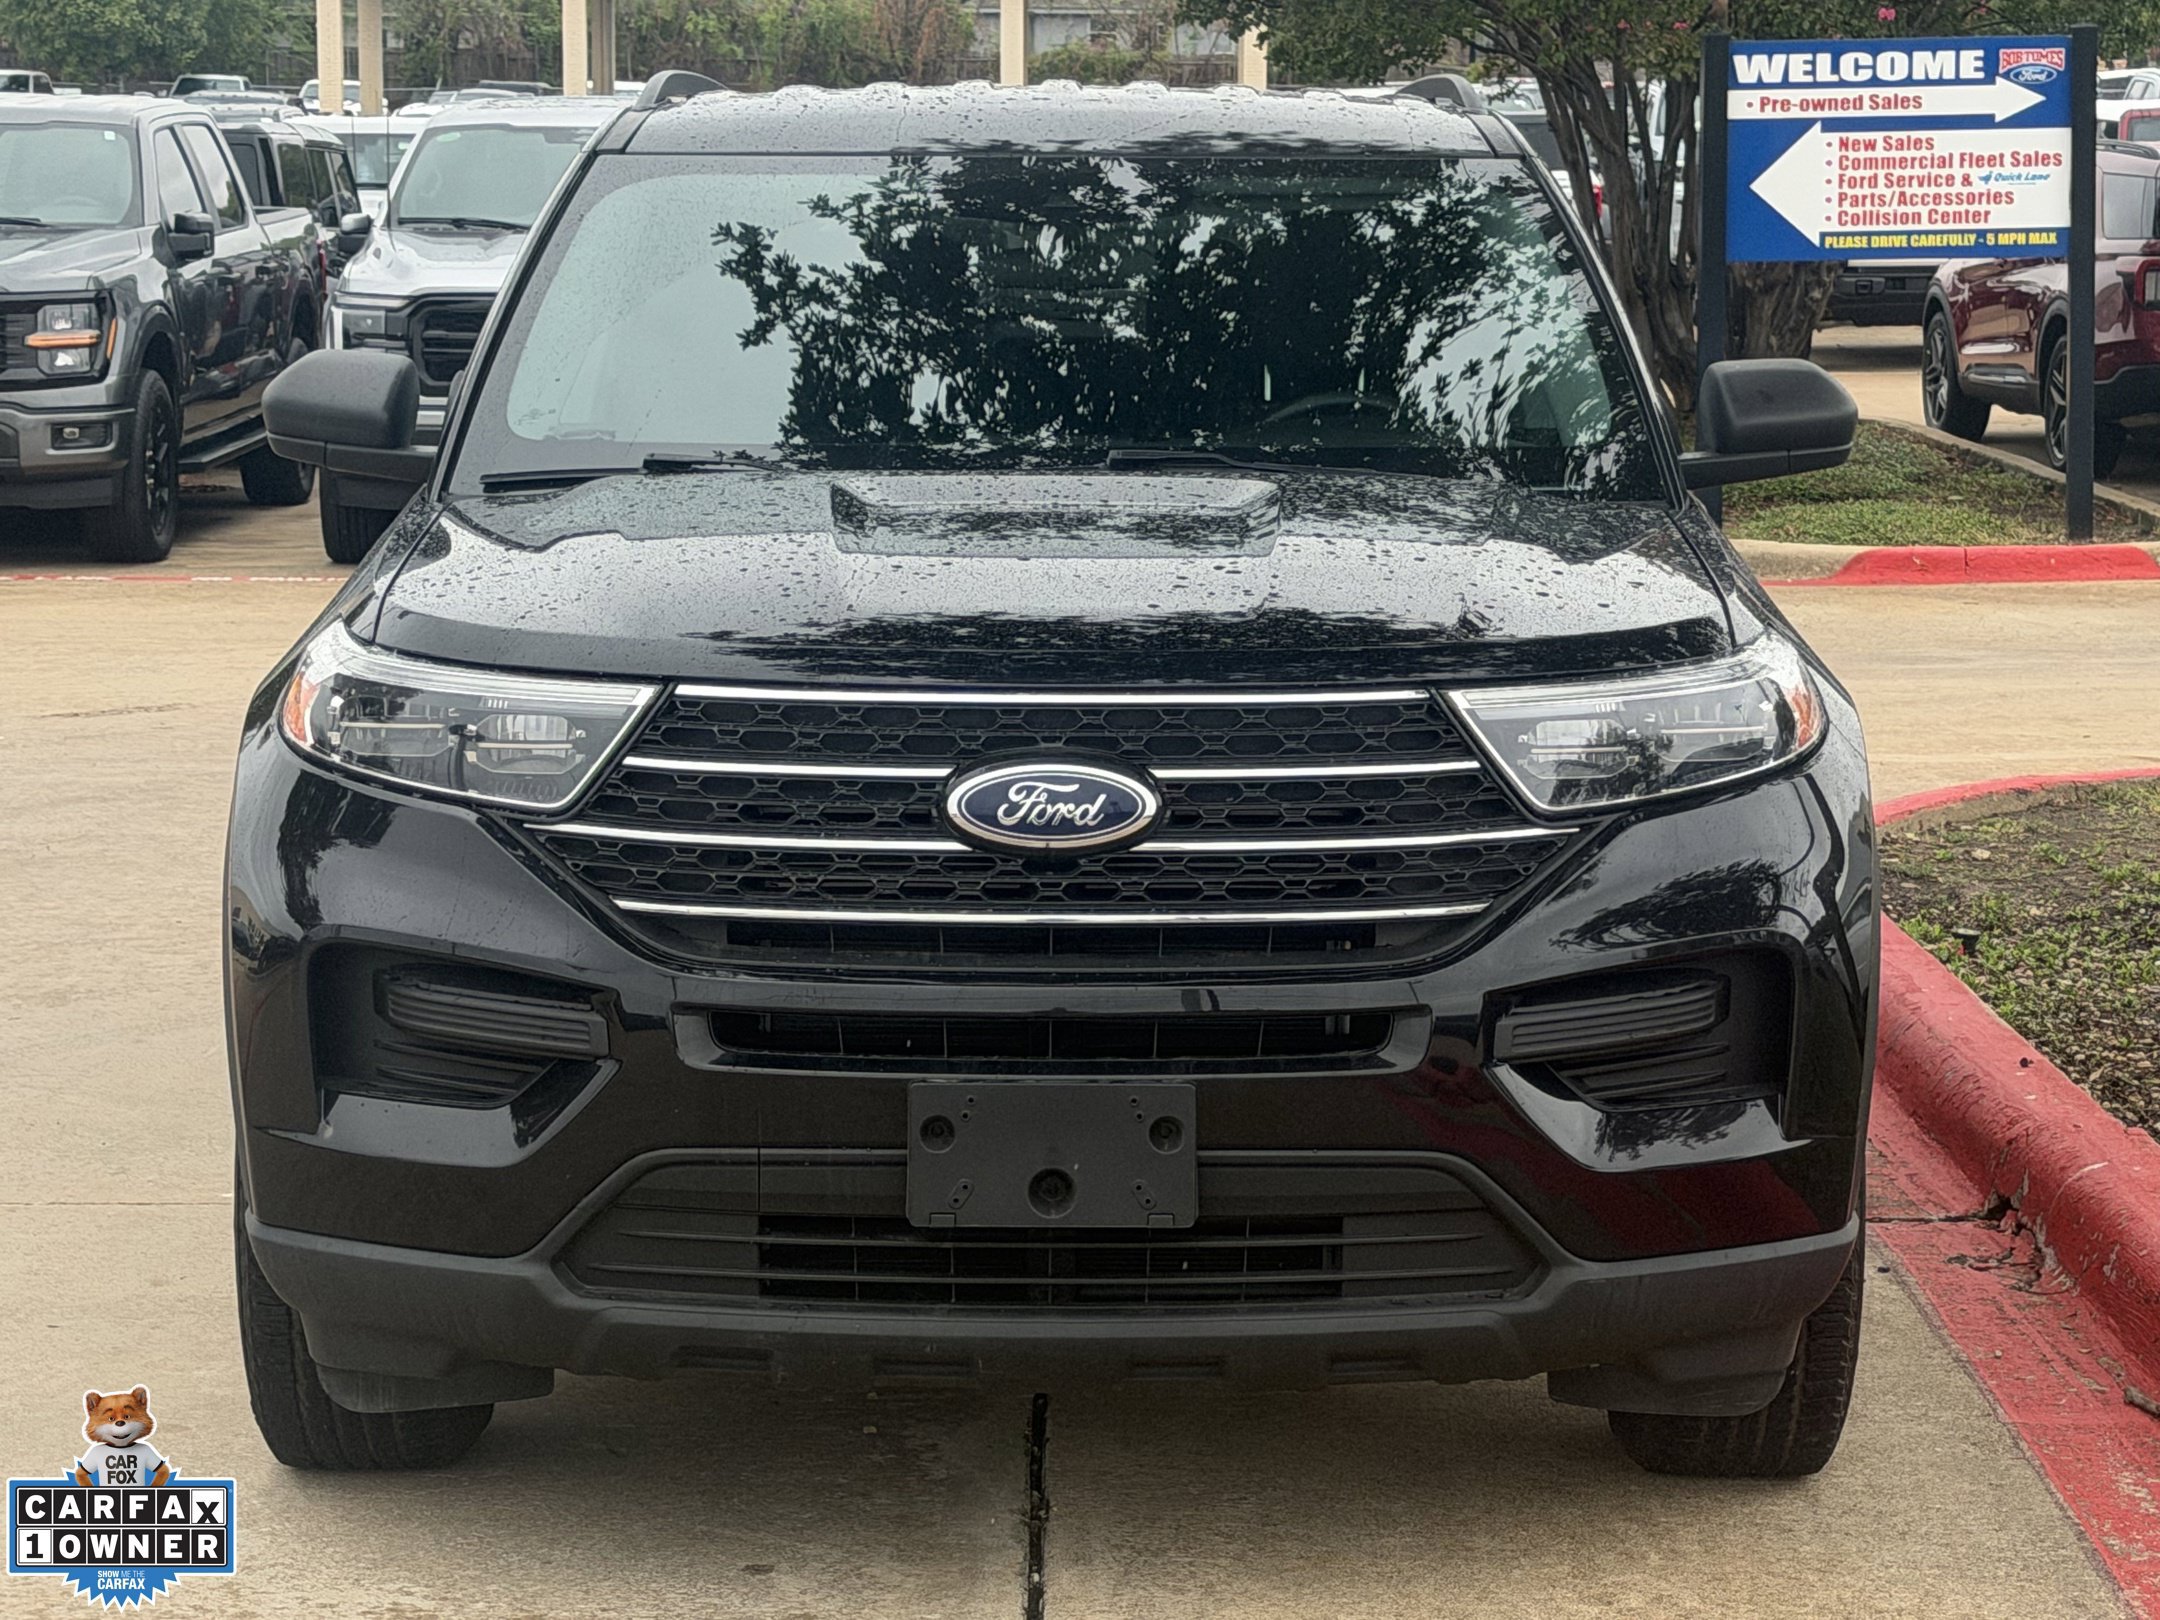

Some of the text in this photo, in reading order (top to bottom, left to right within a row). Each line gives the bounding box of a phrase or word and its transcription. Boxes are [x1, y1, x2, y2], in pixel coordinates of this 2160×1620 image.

[1732, 50, 1985, 84] WELCOME
[2018, 68, 2048, 81] Ford
[1759, 93, 1923, 113] Pre-owned Sales
[1838, 135, 1935, 152] New Sales
[1838, 150, 2063, 171] Commercial Fleet Sales
[1838, 172, 1973, 189] Ford Service &
[1994, 172, 2050, 182] Quick Lane
[1838, 188, 2015, 209] Parts/Accessories
[1838, 208, 1991, 226] Collision Center
[1824, 235, 1868, 249] PLEASE
[1870, 234, 1908, 248] DRIVE
[1910, 233, 1976, 248] CAREFULLY
[1986, 232, 1995, 246] 5
[1998, 232, 2026, 245] MPH
[2028, 231, 2057, 245] MAX
[997, 781, 1107, 827] Ford
